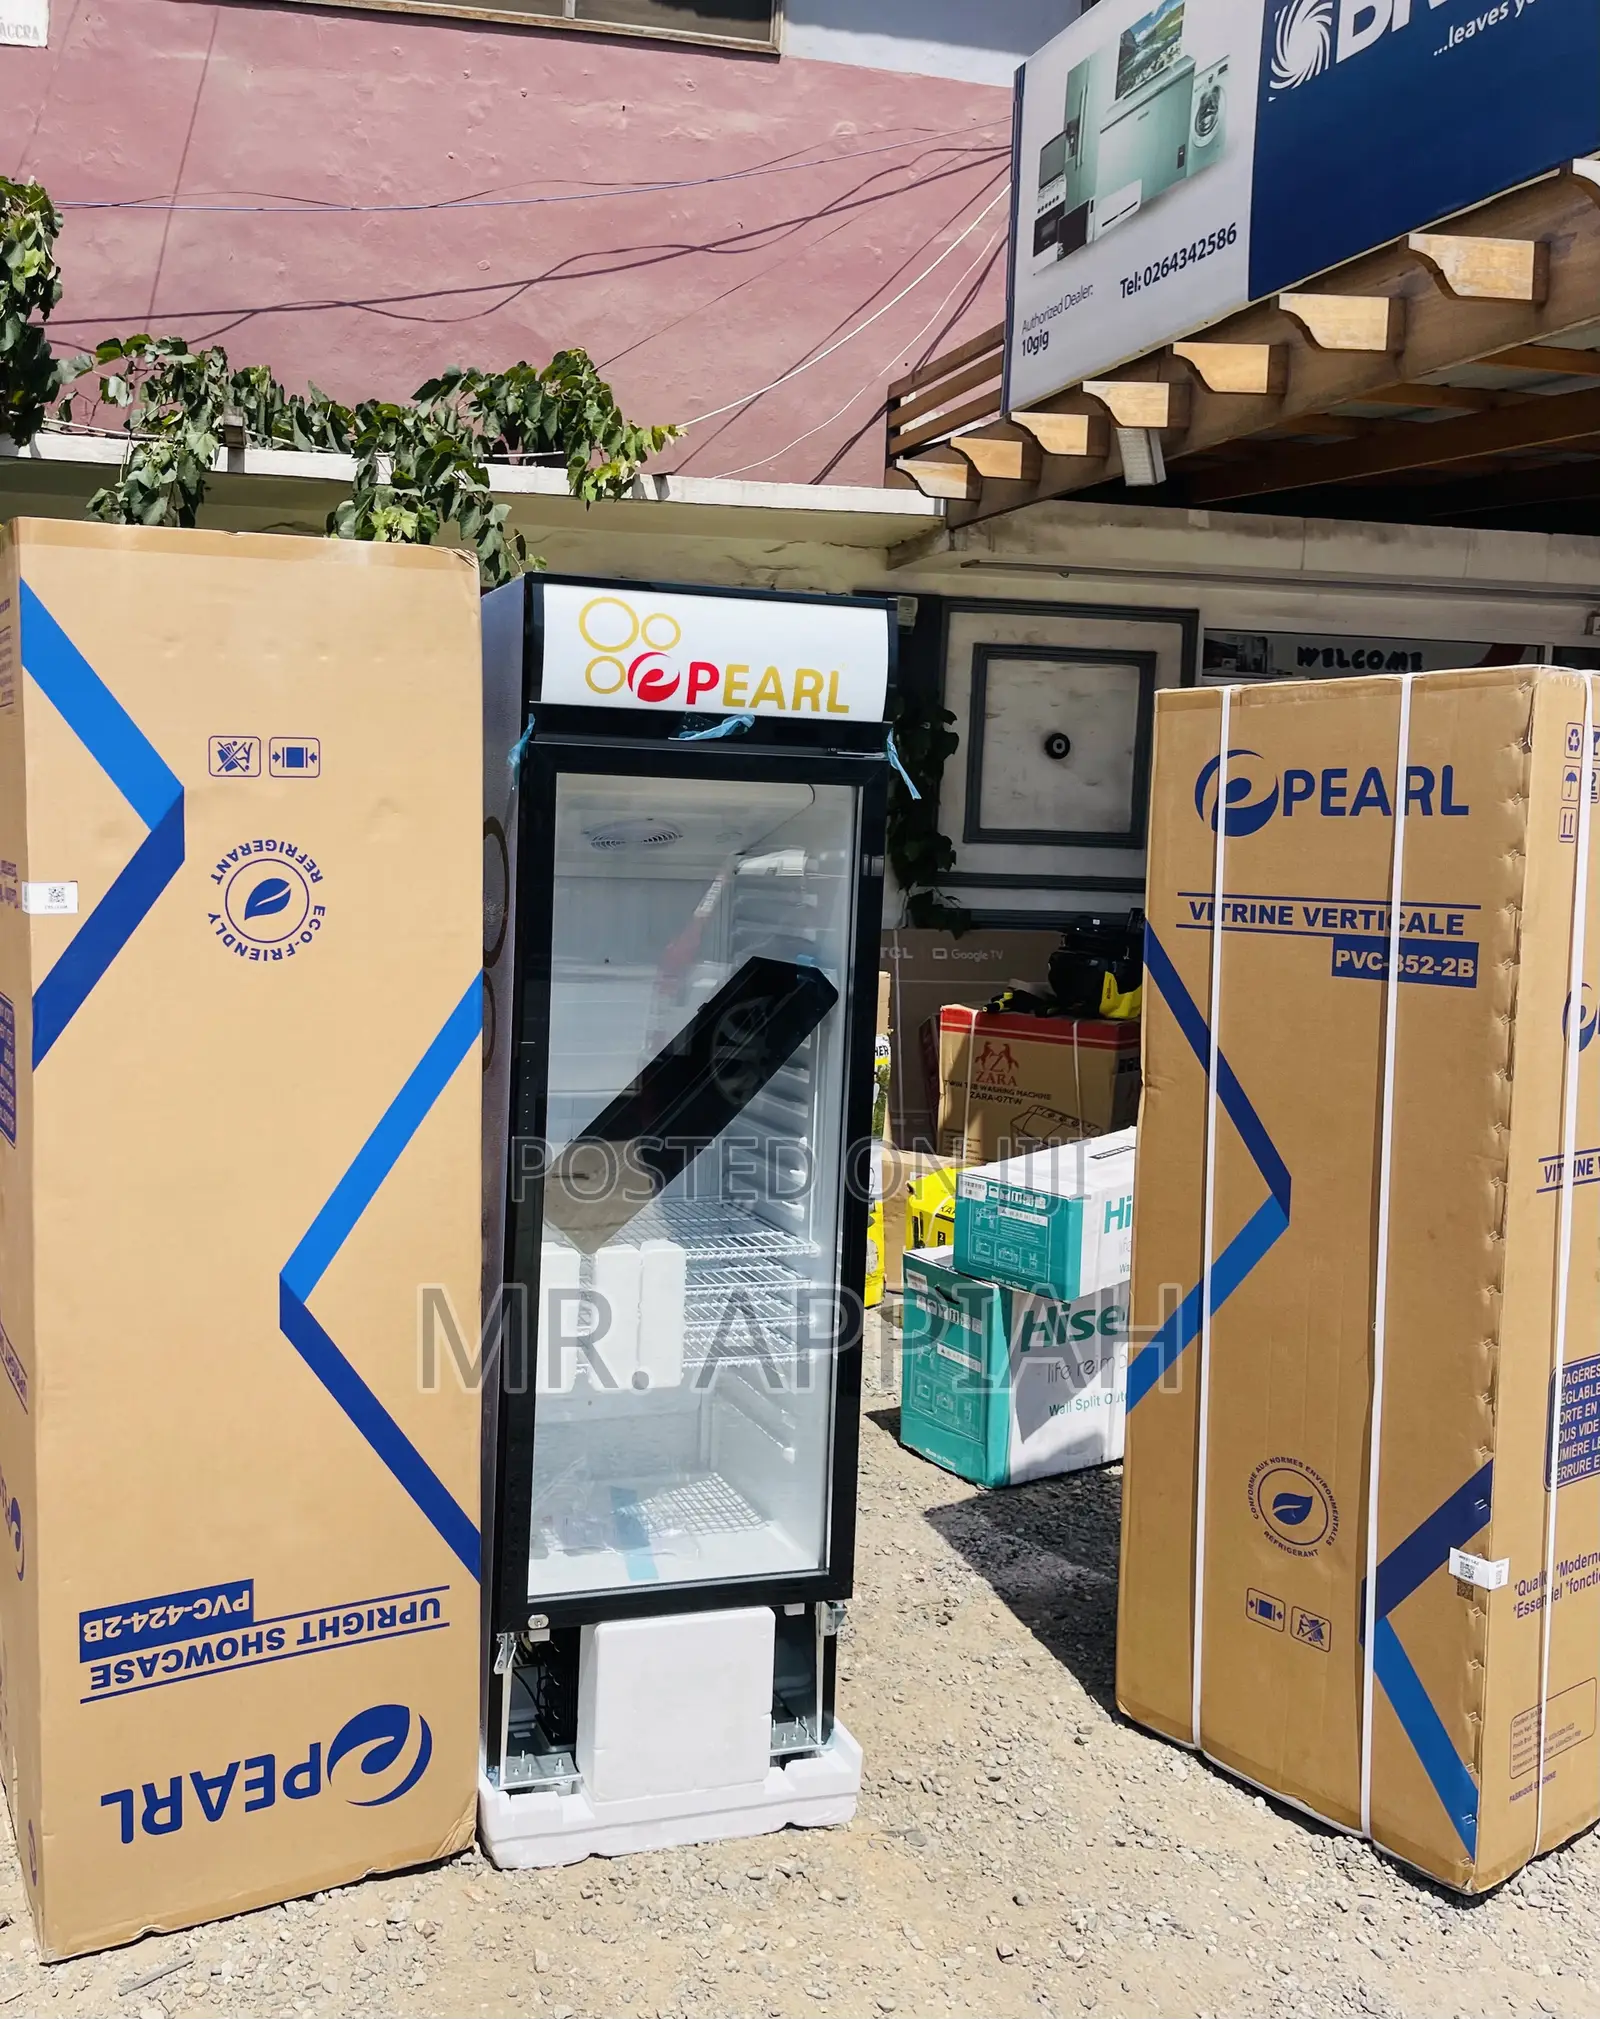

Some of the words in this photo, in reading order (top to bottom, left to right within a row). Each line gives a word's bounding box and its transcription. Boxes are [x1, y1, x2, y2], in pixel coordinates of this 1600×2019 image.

[1120, 271, 1142, 298] Tel:
[1144, 222, 1237, 287] 0264342586
[1021, 299, 1063, 335] Authorized
[1063, 283, 1094, 311] Dealer:
[1021, 330, 1050, 356] 10gig
[1296, 645, 1424, 672] WELCOME
[685, 660, 850, 714] PEARL
[1282, 764, 1470, 817] PEARL
[210, 838, 324, 885] REFRIGERANT
[207, 904, 326, 962] ECO-FRIENDLY
[1188, 901, 1294, 926] VITRINE
[1302, 907, 1465, 936] VERTICALE
[951, 948, 989, 963] Google
[990, 949, 1004, 960] TV
[975, 1070, 1018, 1087] ZARA
[980, 1084, 1014, 1096] WASHING
[1015, 1089, 1052, 1101] MACHINE
[1544, 1157, 1594, 1184] VITINE
[1047, 1359, 1071, 1385] life
[1049, 1400, 1072, 1417] Wall
[1075, 1395, 1101, 1412] Split
[1585, 1400, 1598, 1418] EN
[1579, 1418, 1599, 1438] VIDE
[1255, 1460, 1269, 1474] AUX
[1269, 1456, 1304, 1468] NORMES
[83, 1589, 250, 1643] PVC-424-2B
[1513, 1582, 1563, 1619] Esseniel
[296, 1597, 442, 1646] UPRIGHT
[90, 1626, 286, 1690] SHOWCASE
[100, 1741, 322, 1845] PEARL
